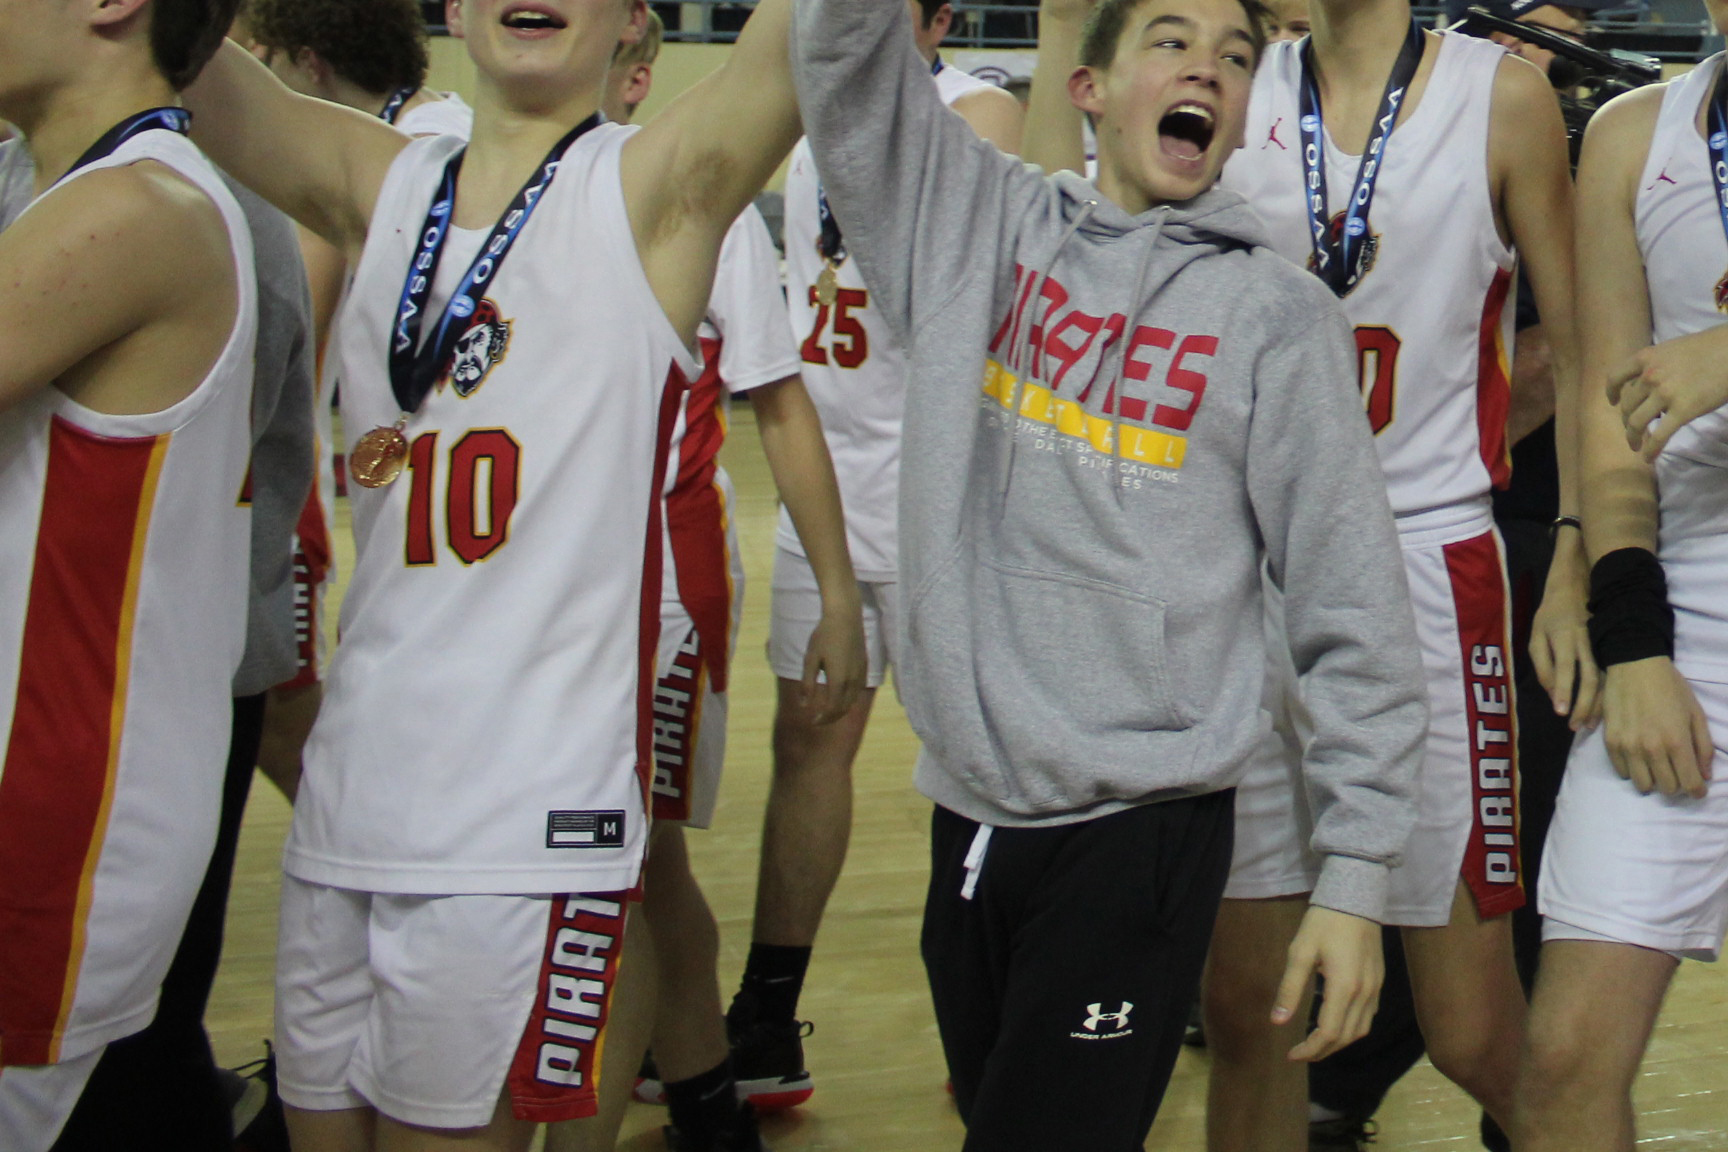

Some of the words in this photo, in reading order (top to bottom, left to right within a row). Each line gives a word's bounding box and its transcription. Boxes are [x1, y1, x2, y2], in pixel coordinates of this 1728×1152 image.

[1305, 143, 1330, 269] OSSAA
[1356, 86, 1404, 206] OSSAA
[472, 160, 563, 285] OSSAA
[394, 225, 441, 351] OSSAA
[404, 425, 523, 568] 10
[1471, 644, 1518, 884] PIRATES
[602, 821, 617, 837] M
